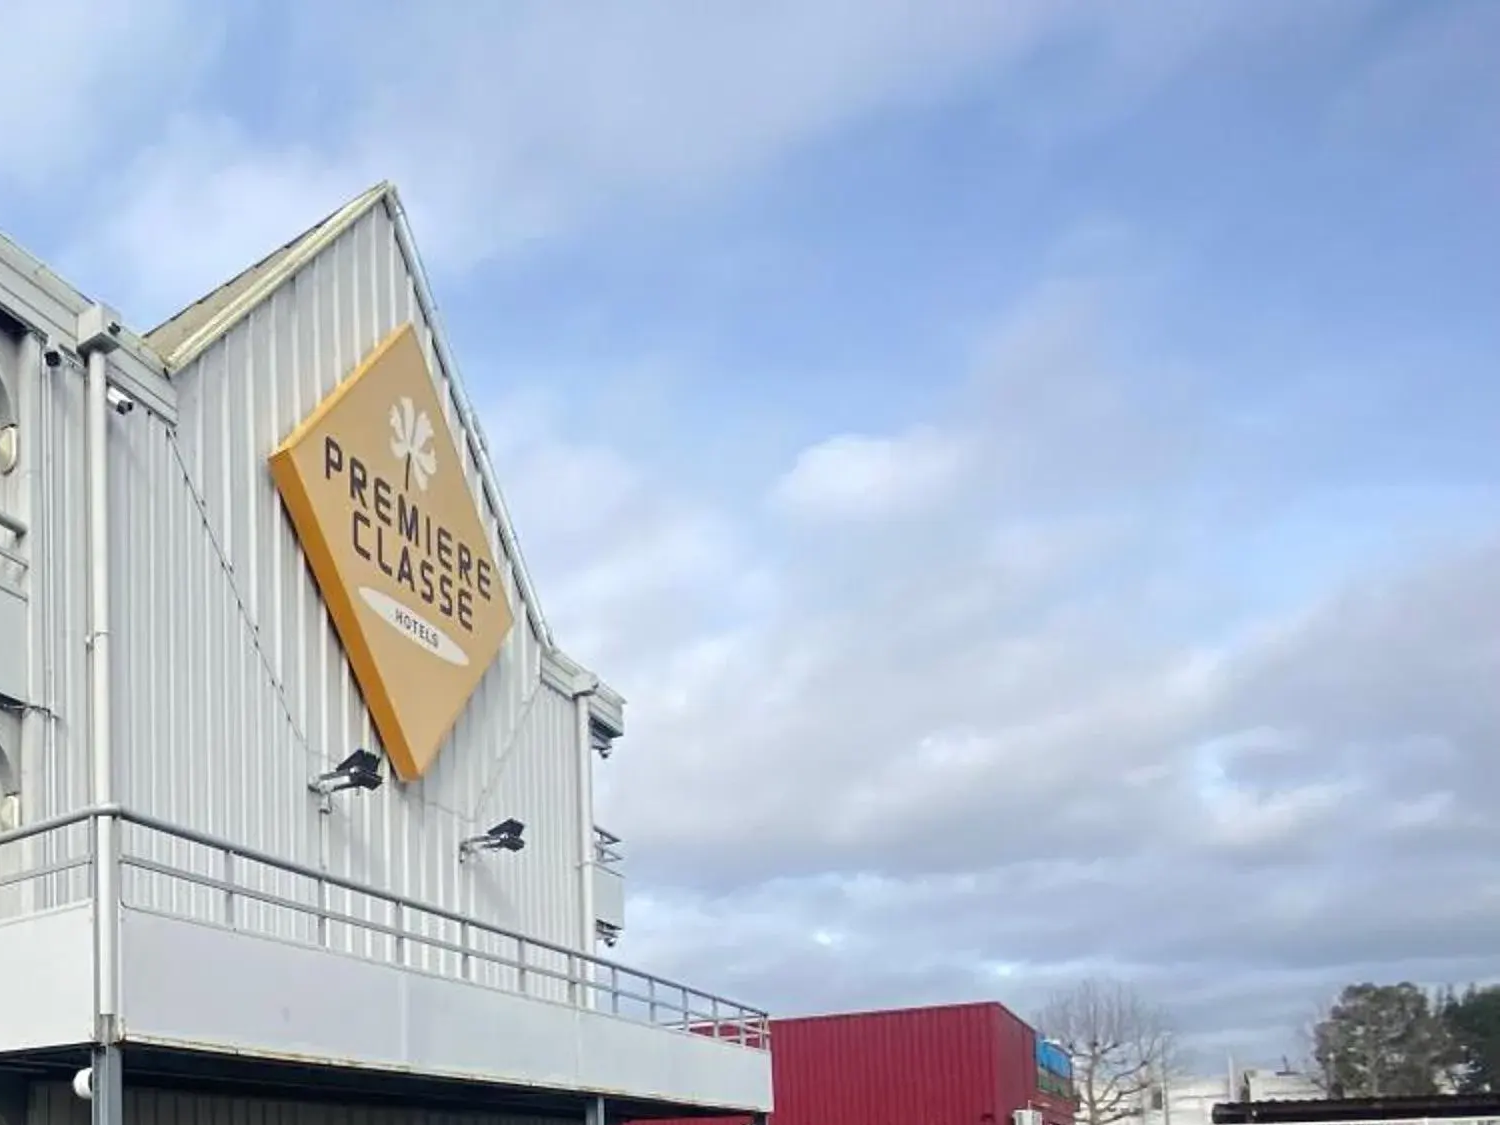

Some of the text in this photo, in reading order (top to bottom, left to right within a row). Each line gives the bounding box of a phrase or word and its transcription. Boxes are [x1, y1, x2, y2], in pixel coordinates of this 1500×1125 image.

[324, 436, 492, 602] PREMIERE
[352, 512, 473, 632] CLASSE
[395, 608, 439, 649] HOTELS
